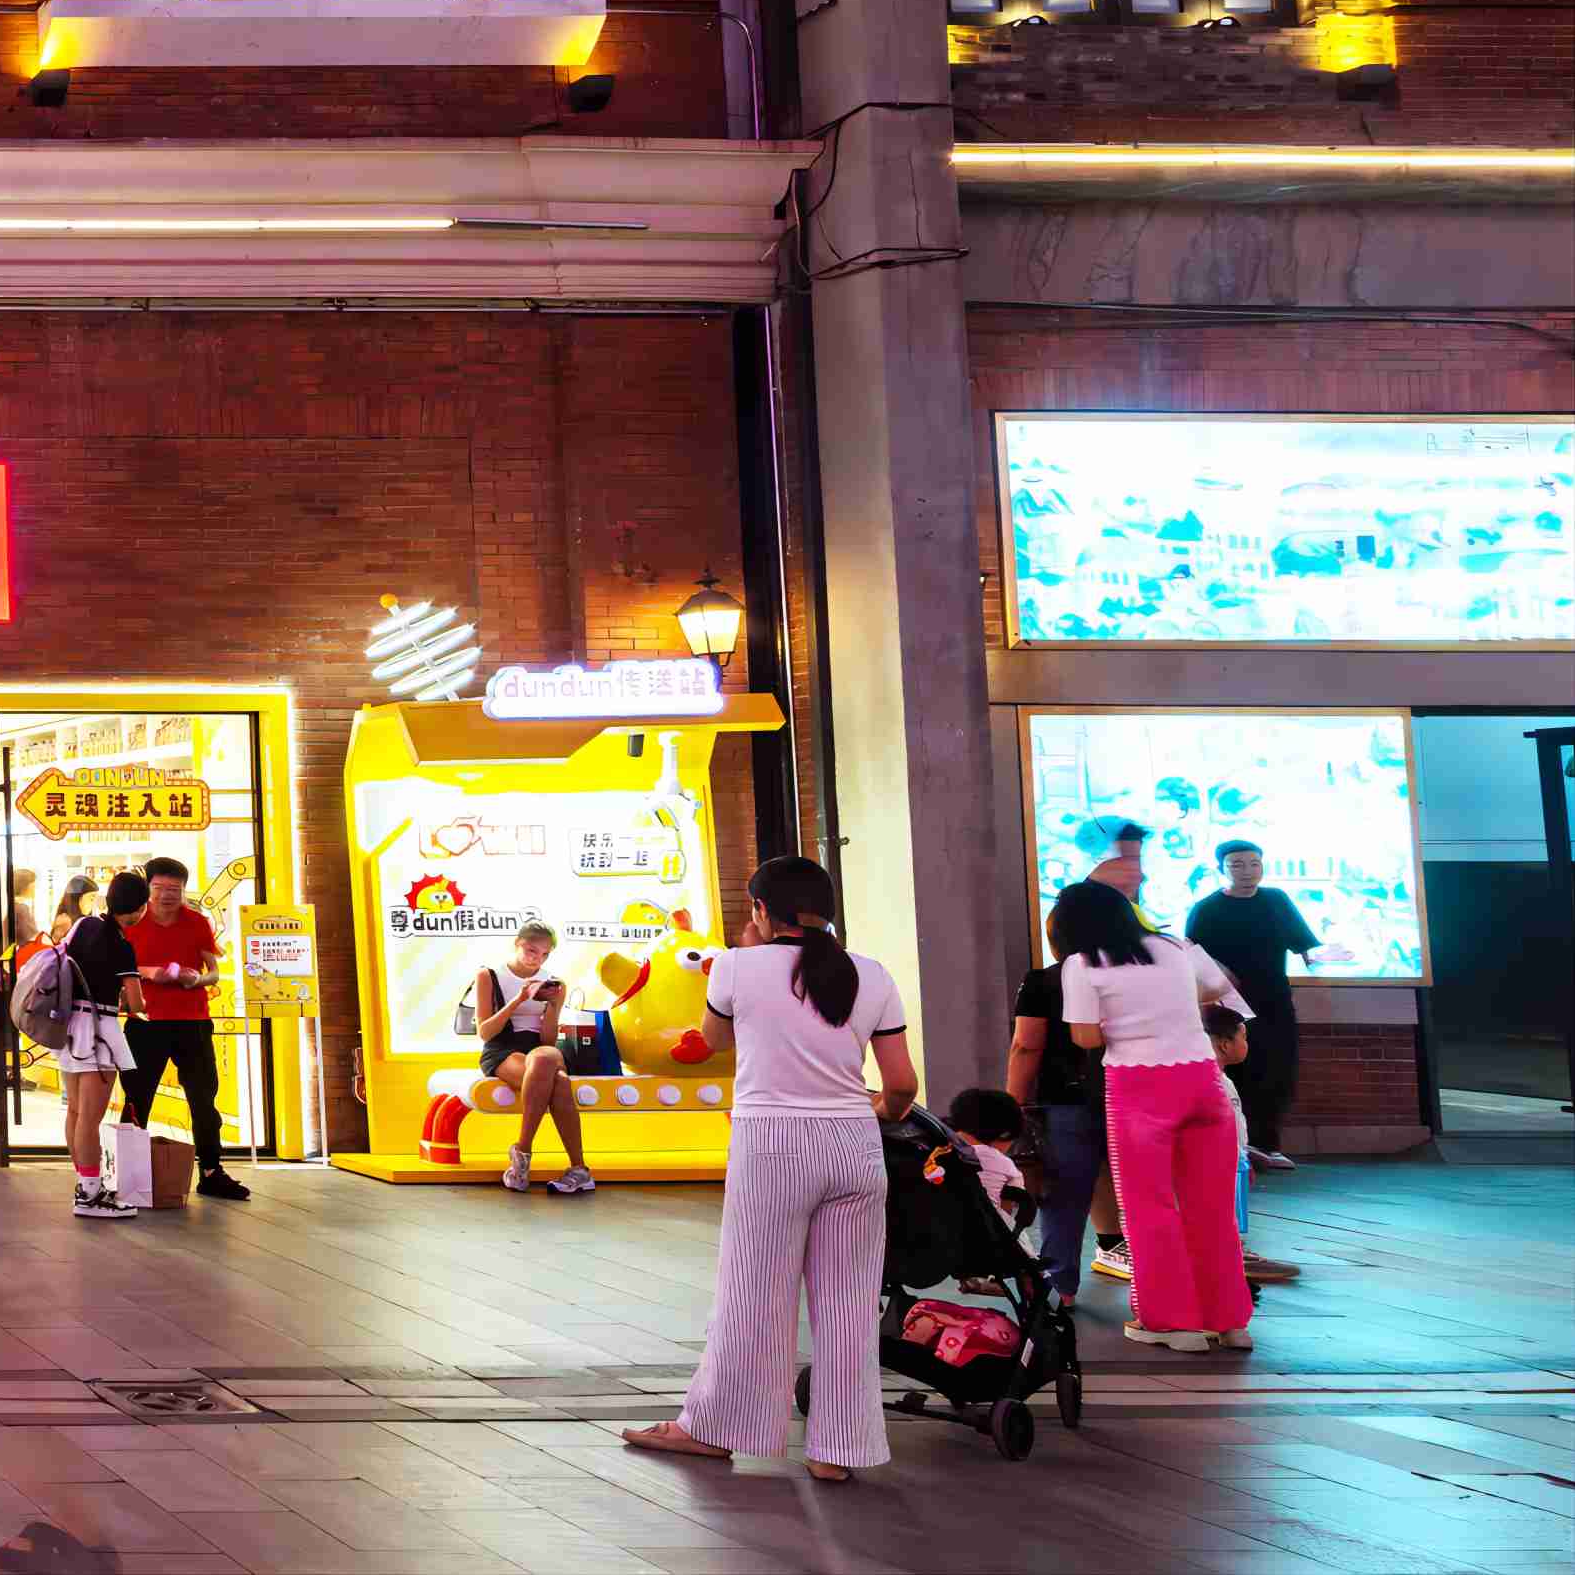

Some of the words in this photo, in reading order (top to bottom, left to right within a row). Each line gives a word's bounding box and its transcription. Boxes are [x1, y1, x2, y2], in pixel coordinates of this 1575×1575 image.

[45, 792, 193, 818] 灵魂注入站
[390, 908, 538, 933] 尊dun假dun
